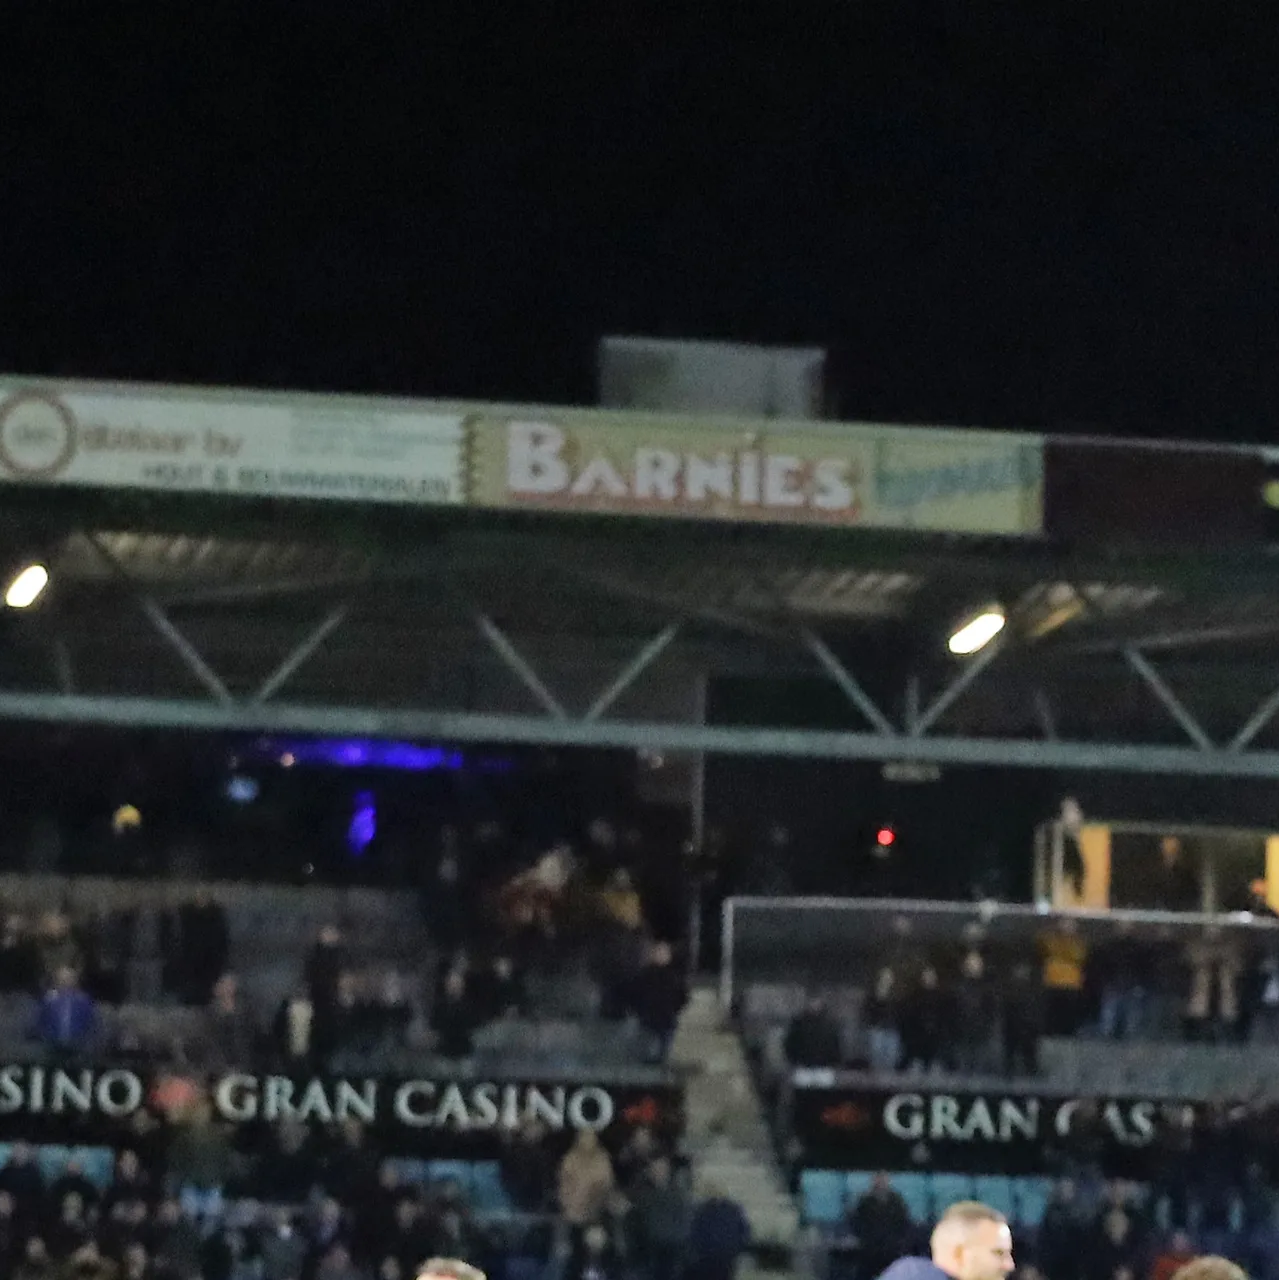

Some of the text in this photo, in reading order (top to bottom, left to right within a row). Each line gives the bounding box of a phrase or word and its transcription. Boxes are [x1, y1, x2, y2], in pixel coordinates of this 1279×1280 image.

[217, 1072, 614, 1132] GRAN CASINO
[882, 1094, 1038, 1141] GRAN
